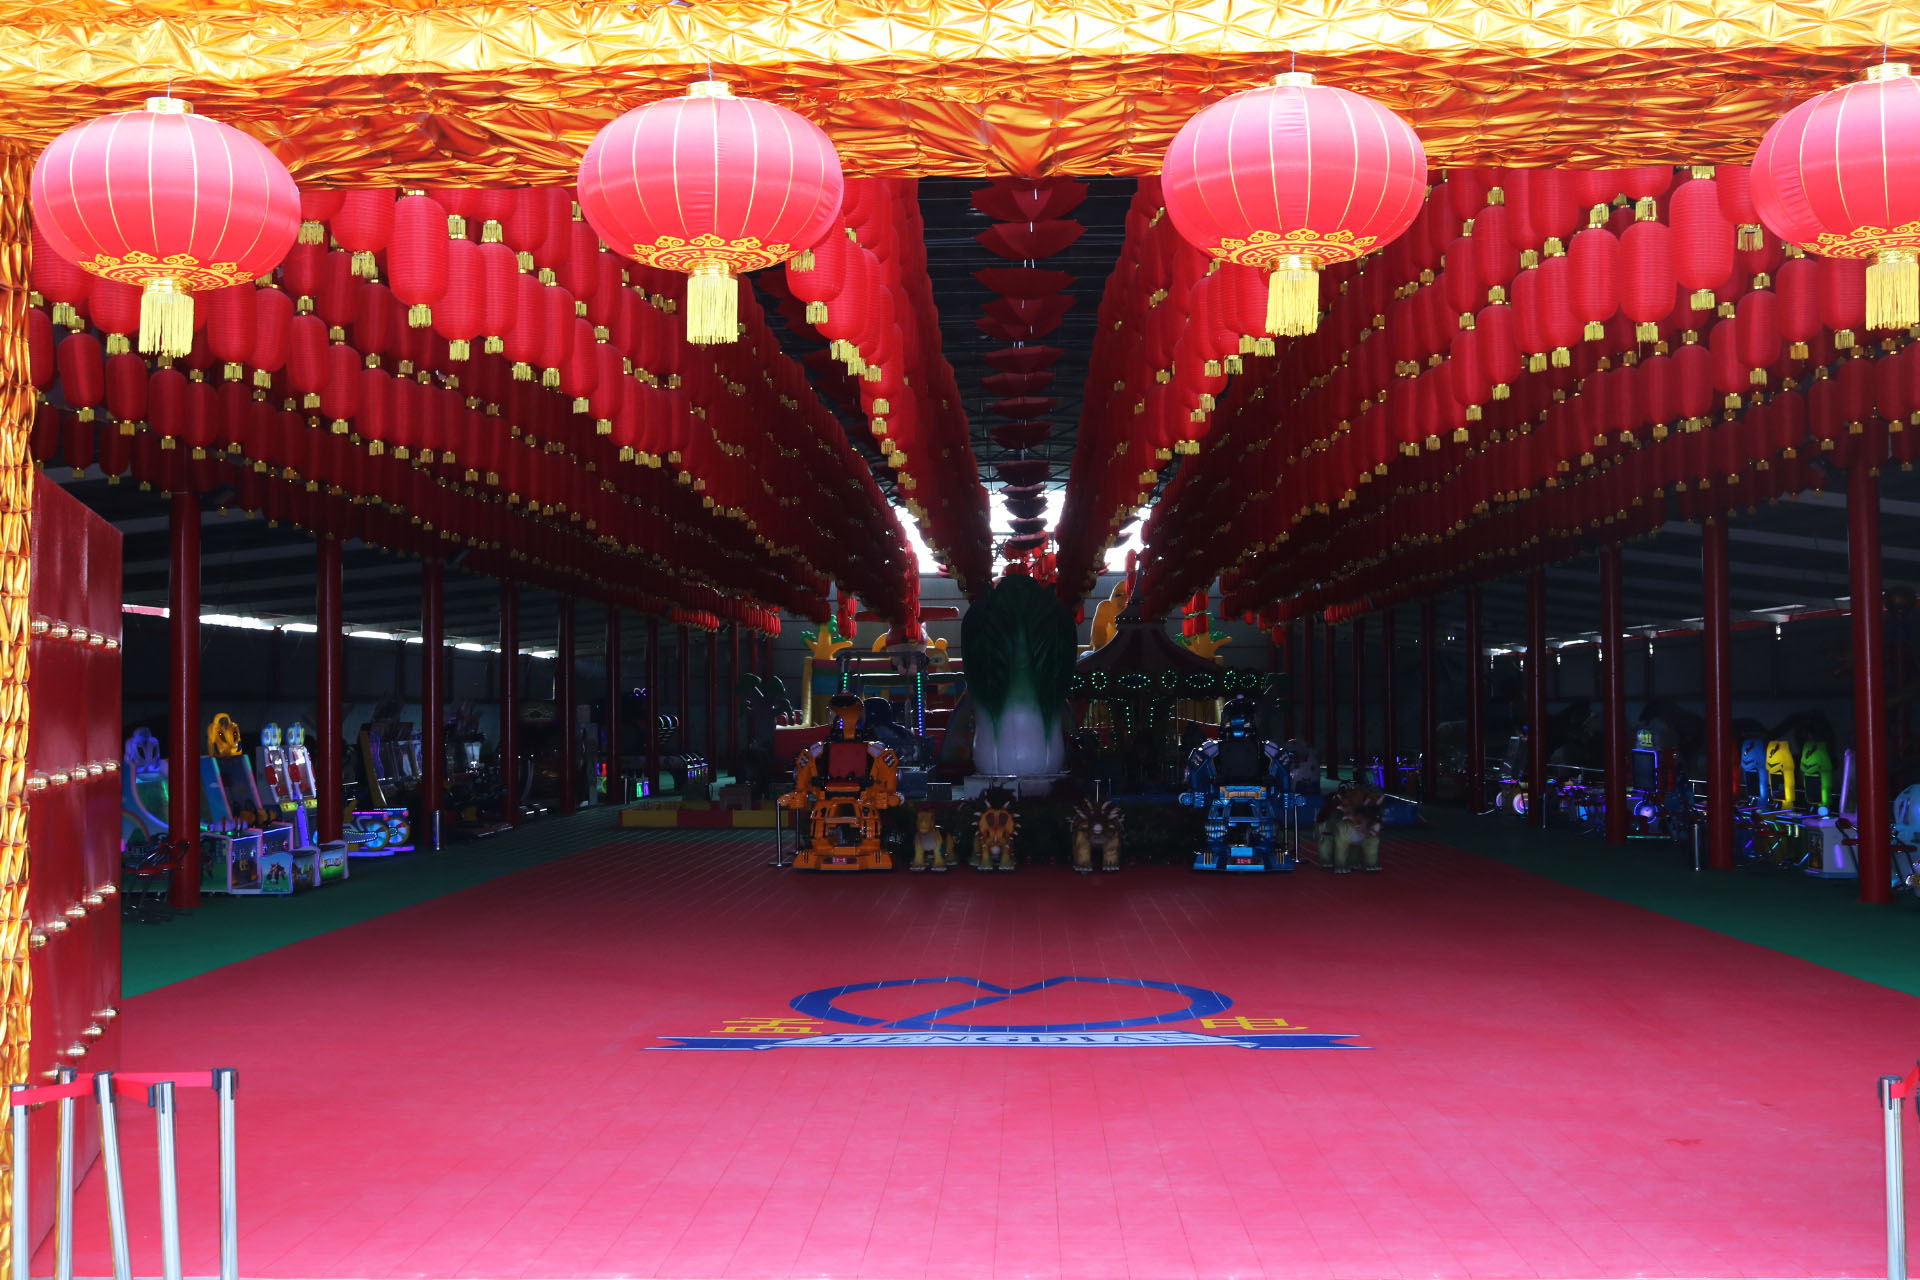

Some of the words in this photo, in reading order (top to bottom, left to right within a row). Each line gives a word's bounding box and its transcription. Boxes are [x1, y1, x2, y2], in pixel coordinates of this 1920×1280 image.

[710, 1017, 824, 1034] 孟
[1200, 1016, 1308, 1030] 电
[810, 1033, 1205, 1043] MENGDIAN
